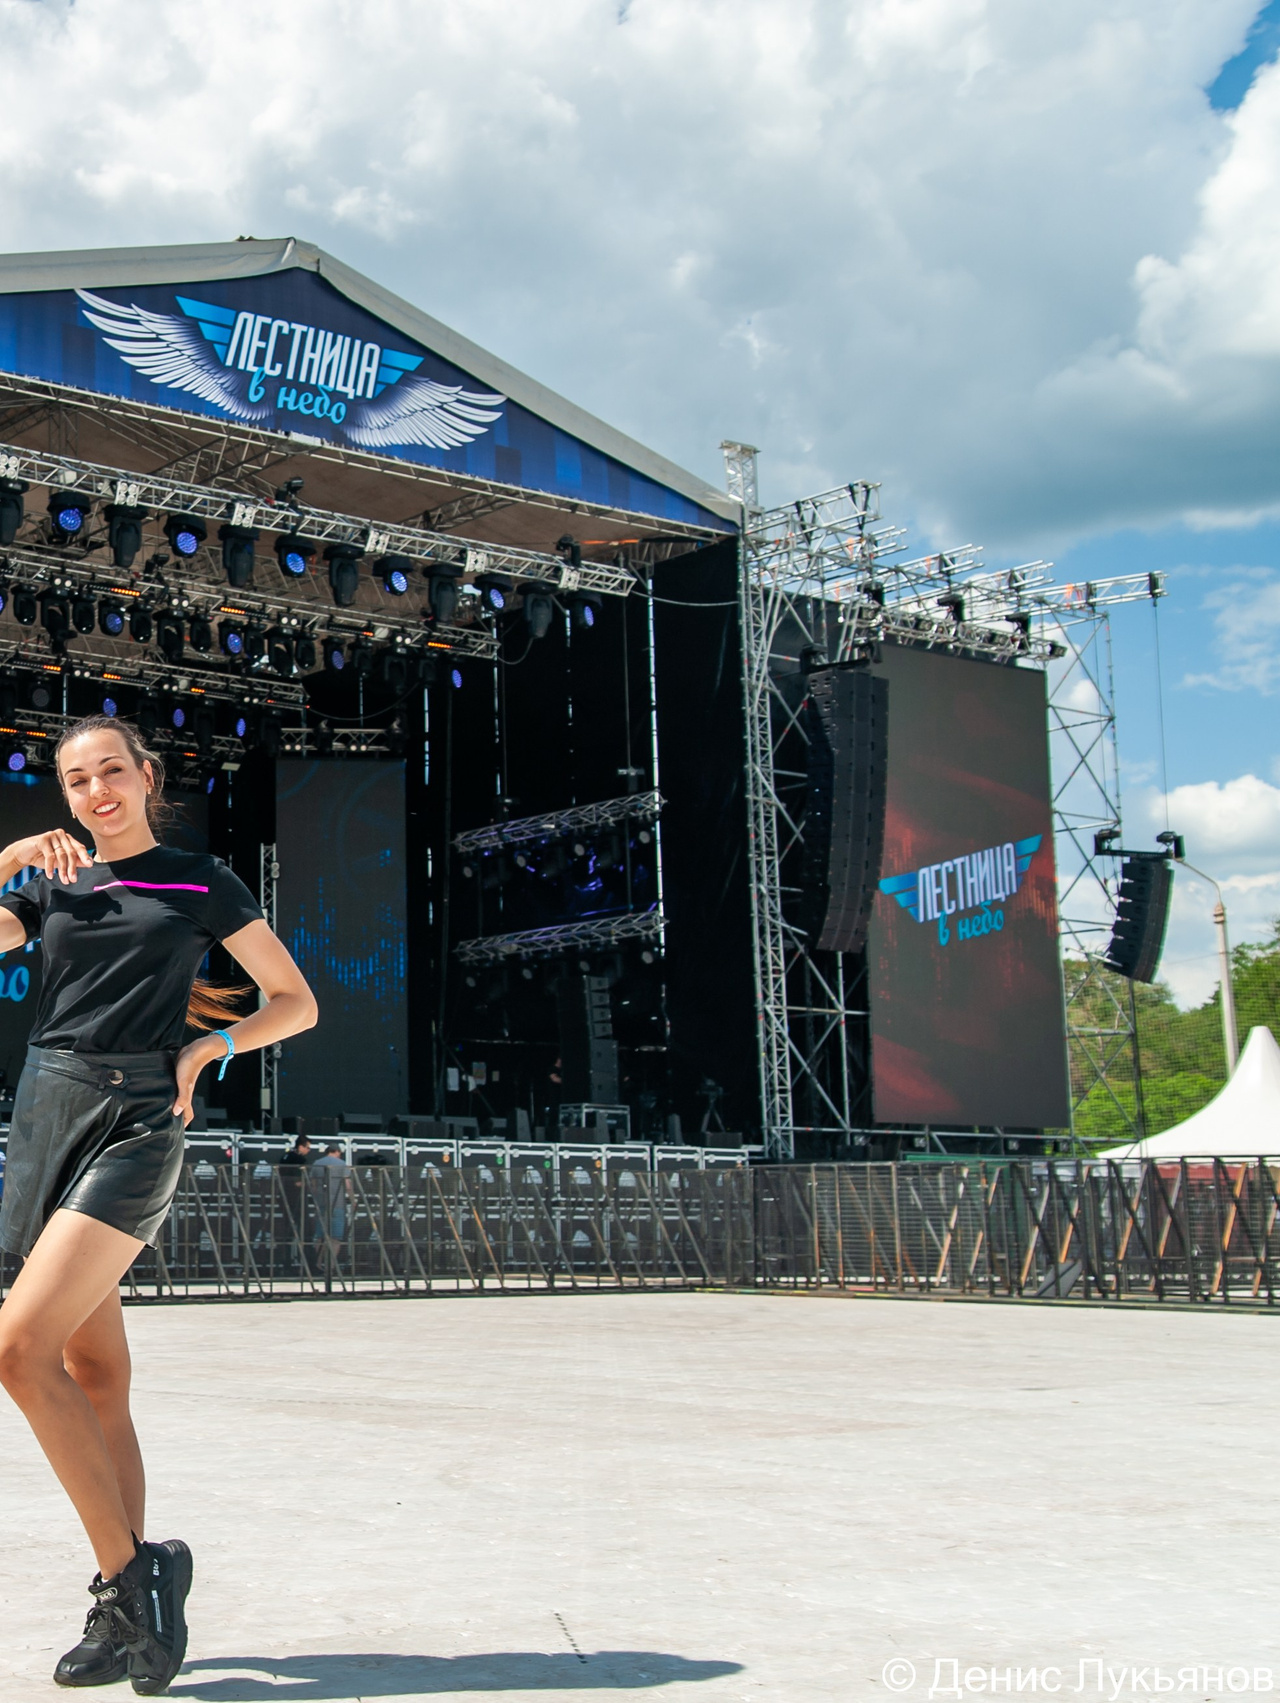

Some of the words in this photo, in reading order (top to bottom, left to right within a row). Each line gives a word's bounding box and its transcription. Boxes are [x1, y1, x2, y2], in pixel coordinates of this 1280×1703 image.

[226, 311, 381, 400] ЛЕСТНИЦА
[248, 369, 266, 403] в
[277, 385, 347, 425] небо
[918, 842, 1018, 924] ЛЕСТНИЦА
[938, 911, 950, 946] в
[957, 901, 1004, 941] небо
